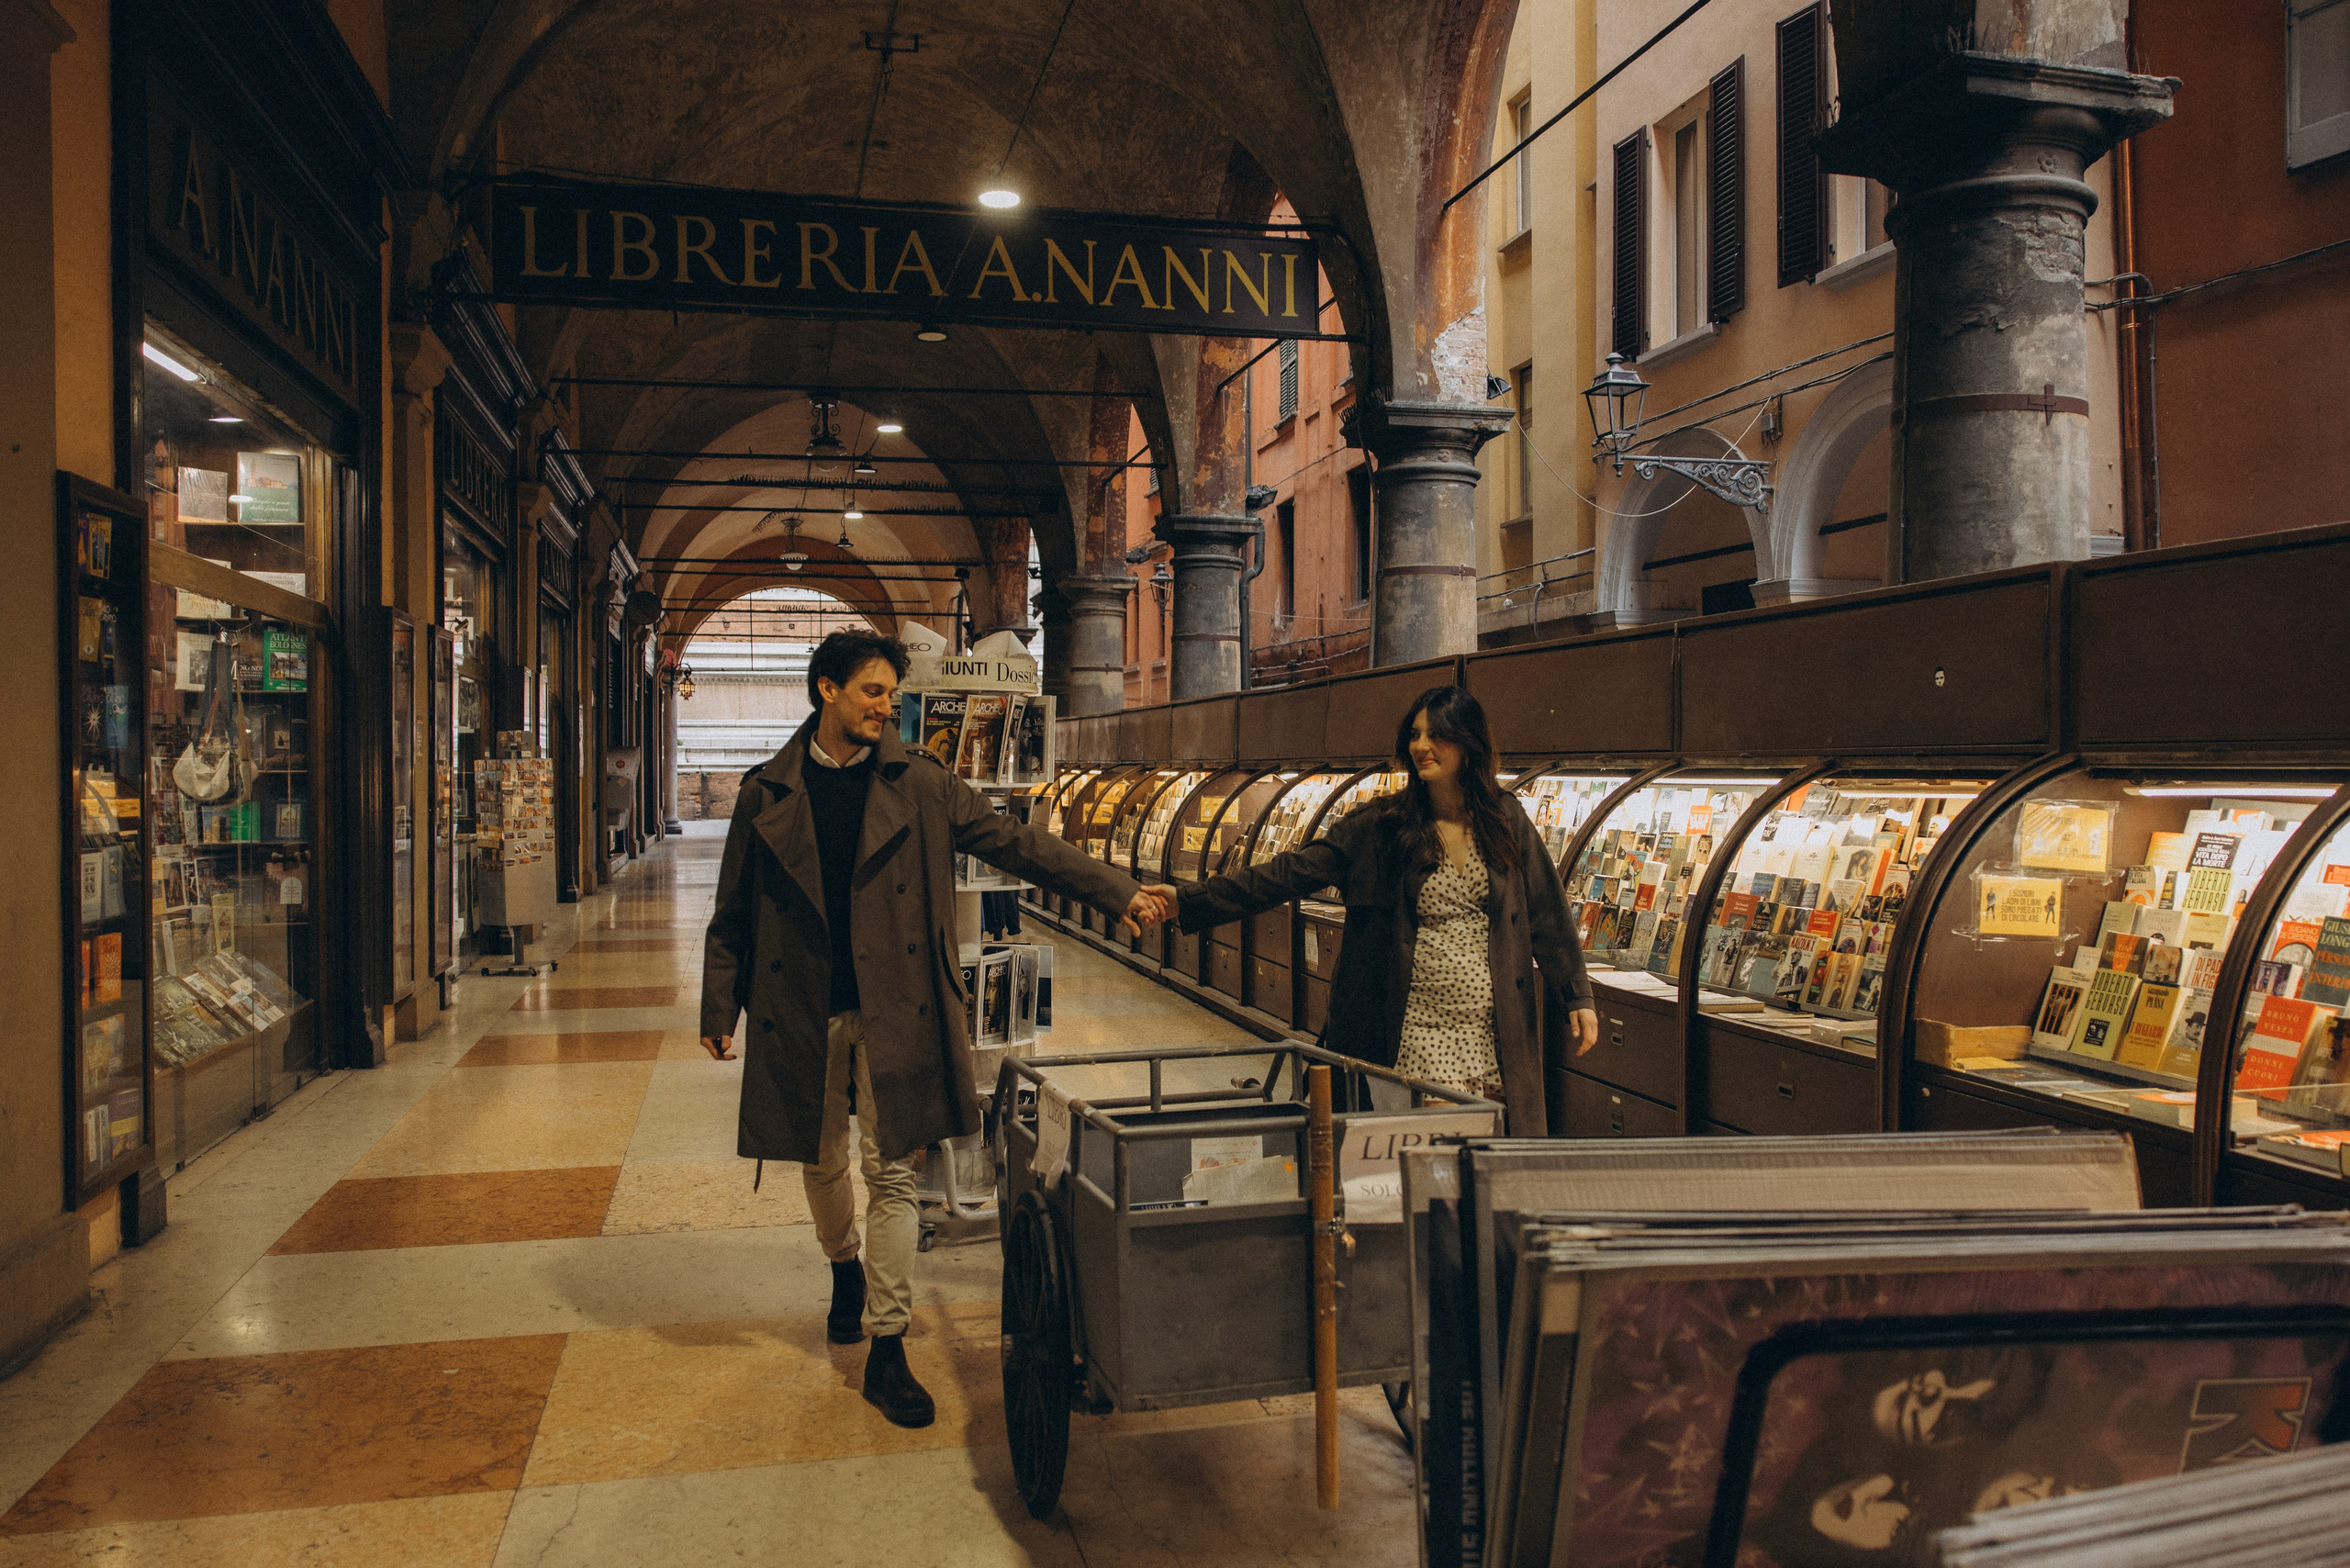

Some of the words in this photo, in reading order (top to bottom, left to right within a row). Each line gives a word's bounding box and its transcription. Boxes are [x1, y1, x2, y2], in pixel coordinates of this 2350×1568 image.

[520, 206, 948, 297] LIBRERIA
[968, 234, 1299, 318] A.NANNI
[451, 420, 509, 539] LIBRERIA
[930, 700, 967, 713] ARCHE
[2191, 857, 2201, 865] LA
[2201, 857, 2226, 868] MORTE
[2195, 850, 2210, 858] VITA
[2210, 851, 2229, 861] DOPO
[2188, 869, 2231, 892] ROBERTO
[2003, 898, 2020, 906] LADRI
[2027, 899, 2042, 907] LIBRI
[2182, 889, 2226, 913] GERVASO
[2001, 905, 2016, 913] SONO
[2017, 905, 2042, 914] PREGATI
[2009, 914, 2040, 924] CIRCOLARE
[2288, 925, 2319, 935] LUCIANO
[1791, 935, 1810, 951] MALCOLM
[2196, 957, 2206, 971] DI
[2090, 971, 2134, 996] ROBERTO
[2191, 972, 2201, 987] IN
[2085, 991, 2128, 1016] GERVASO
[2266, 1010, 2300, 1023] BRUNO
[2264, 1022, 2294, 1035] VESPA
[2249, 1055, 2285, 1069] DONNE
[1361, 1132, 1463, 1160] LIBR
